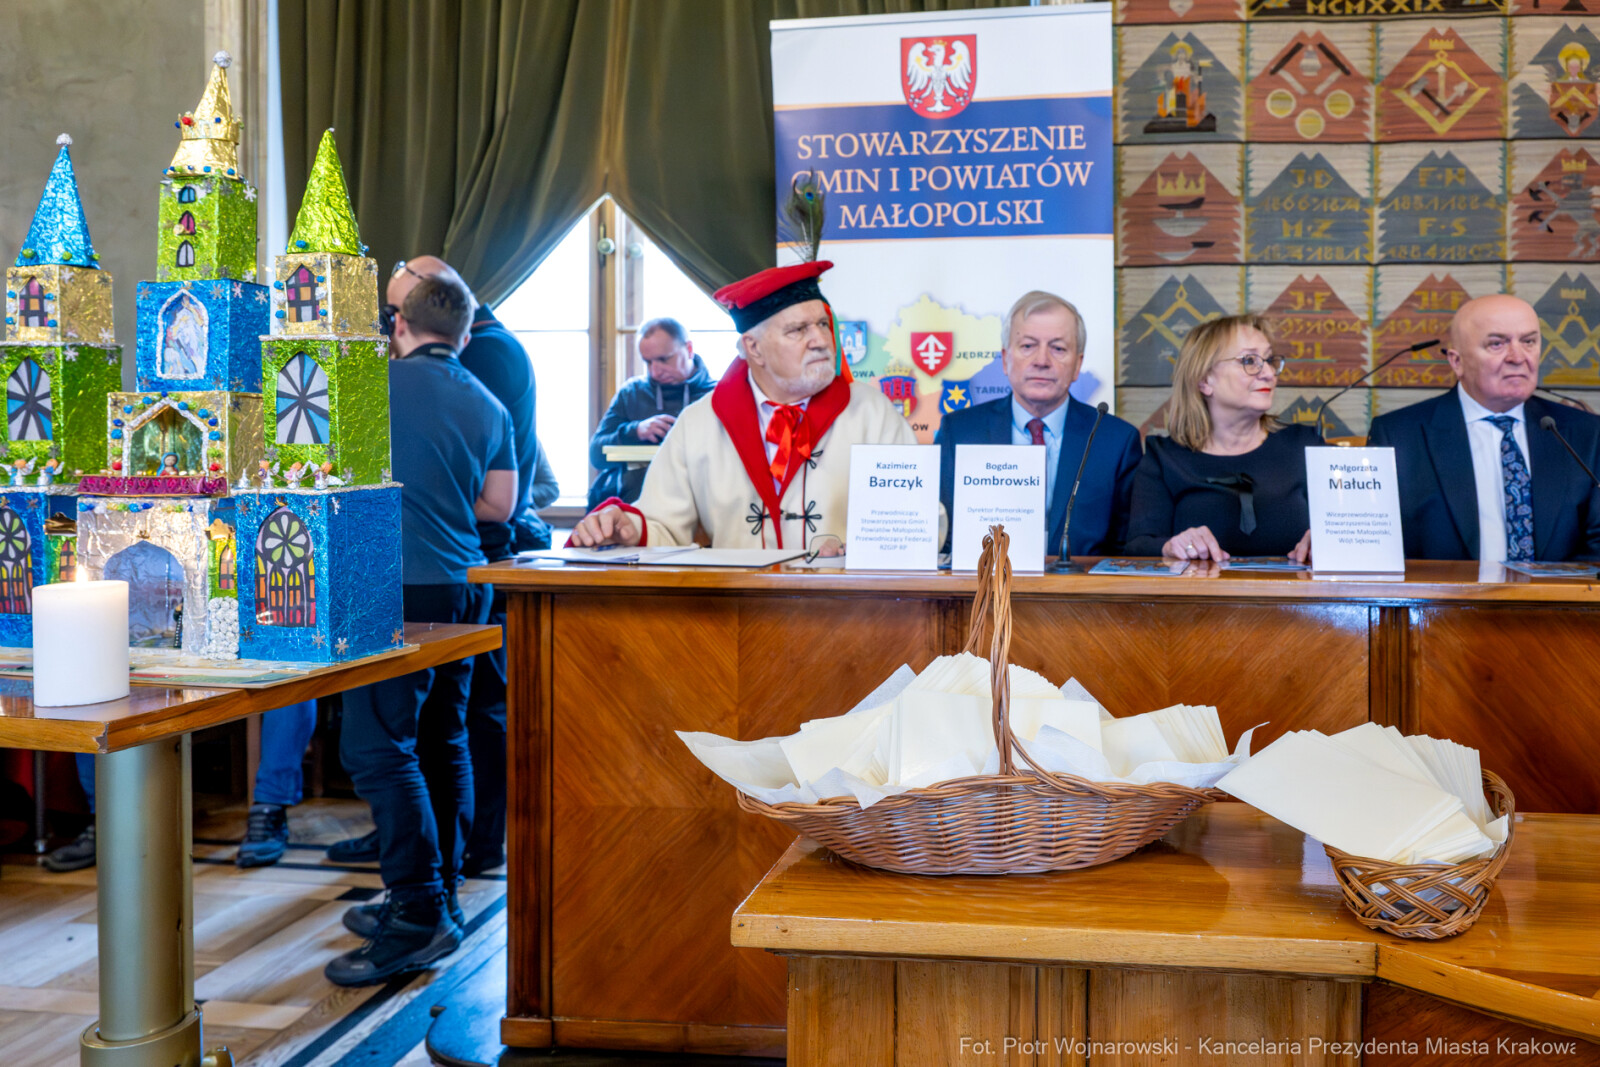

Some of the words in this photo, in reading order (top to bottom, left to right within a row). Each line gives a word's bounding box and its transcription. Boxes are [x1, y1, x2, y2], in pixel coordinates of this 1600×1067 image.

[797, 125, 1087, 159] STOWARZYSZENIE
[791, 168, 881, 194] GMIN
[889, 167, 900, 192] I
[910, 156, 1094, 191] POWIATÓW
[839, 199, 1044, 229] MAŁOPOLSKI
[975, 384, 1012, 394] TARNÓ
[876, 462, 917, 470] Kazimierz
[985, 462, 1018, 471] Bogdan
[1329, 464, 1378, 473] Małgorzata
[869, 476, 923, 490] Barczyk
[963, 475, 1040, 487] Dombrowski
[1329, 477, 1382, 490] Małuch
